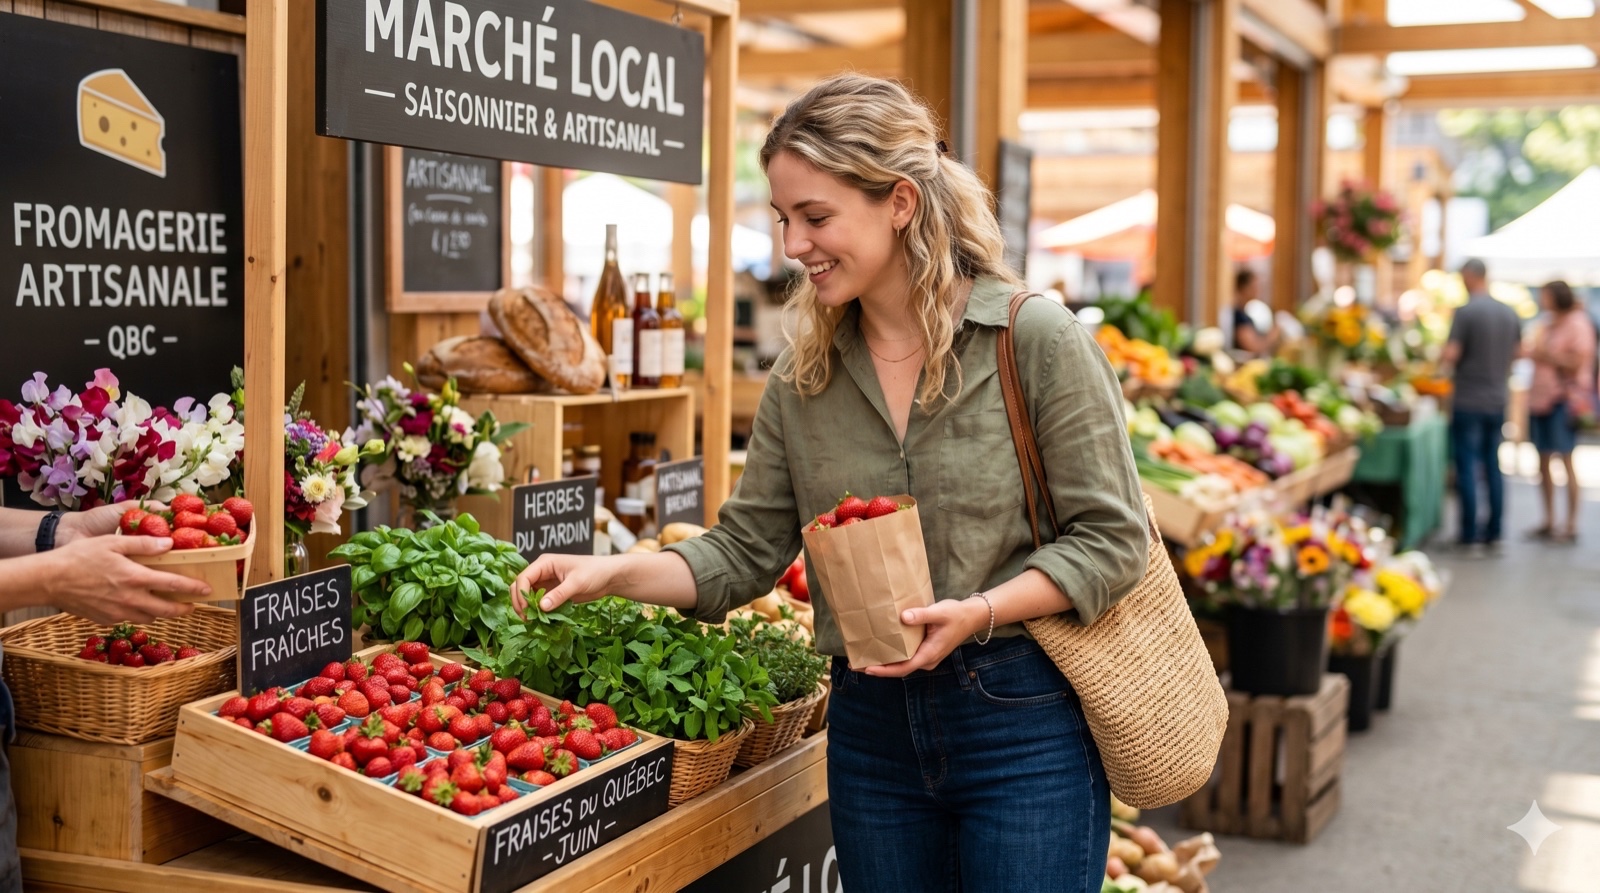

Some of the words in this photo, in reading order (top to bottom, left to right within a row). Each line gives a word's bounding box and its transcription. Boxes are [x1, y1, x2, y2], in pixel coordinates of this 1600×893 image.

[365, 0, 558, 91] MARCHÉ
[571, 33, 685, 117] LOCAL
[404, 81, 539, 137] SAISONNIER
[543, 107, 558, 139] &
[563, 111, 661, 157] ARTISANAL
[406, 156, 494, 194] ARTISANAL
[13, 202, 228, 254] FROMAGERIE
[15, 263, 229, 307] ARTISANALE
[107, 324, 157, 361] QBC
[524, 485, 585, 520] HERBES
[516, 530, 535, 553] DU
[539, 517, 591, 550] JARDIN
[254, 578, 340, 630] FRAISES
[252, 617, 344, 671] FRAÎCHES
[494, 798, 573, 865] FRAISES
[603, 756, 666, 808] QUÉBEC
